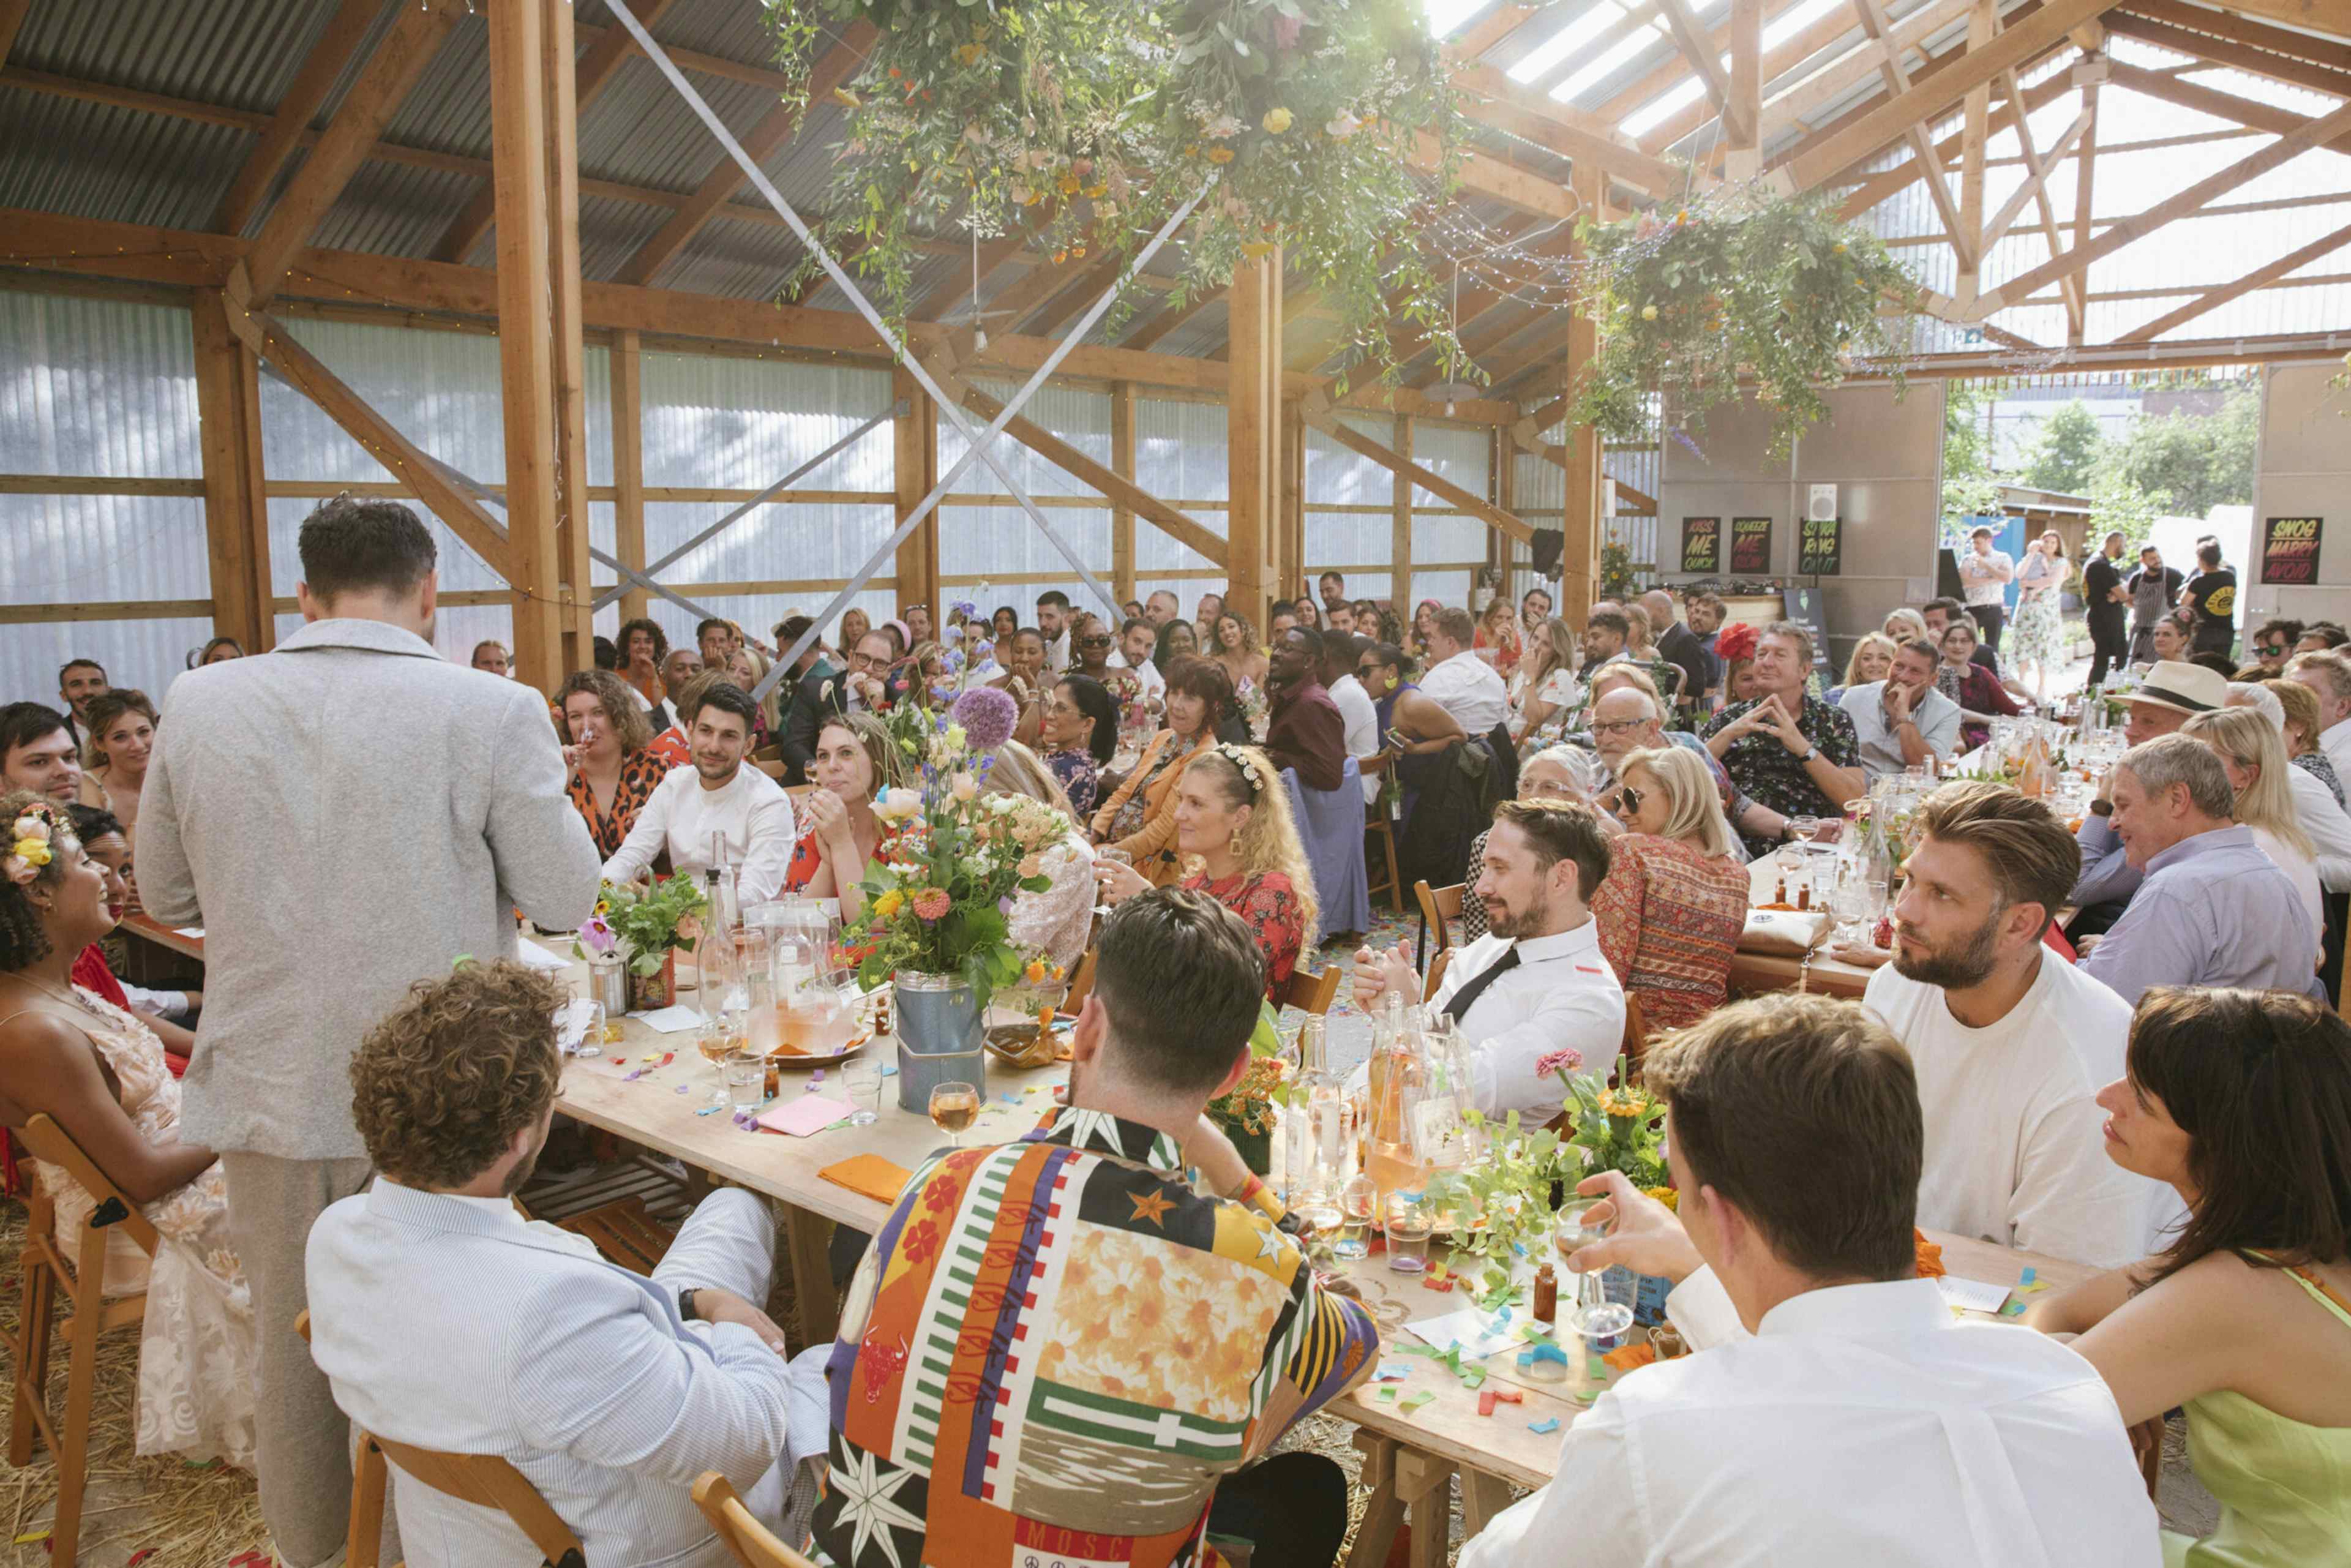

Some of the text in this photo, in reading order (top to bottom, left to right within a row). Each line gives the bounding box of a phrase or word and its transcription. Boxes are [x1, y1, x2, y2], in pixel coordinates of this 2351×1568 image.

[1689, 520, 1714, 533] KISS
[1734, 521, 1769, 533] SQUEEZE
[2273, 520, 2317, 538] SNOG
[1686, 535, 1717, 555] ME
[1734, 535, 1764, 552] ME
[2267, 541, 2319, 557] MARRY
[1685, 557, 1715, 571] QUICK
[2266, 562, 2311, 579] AVOID
